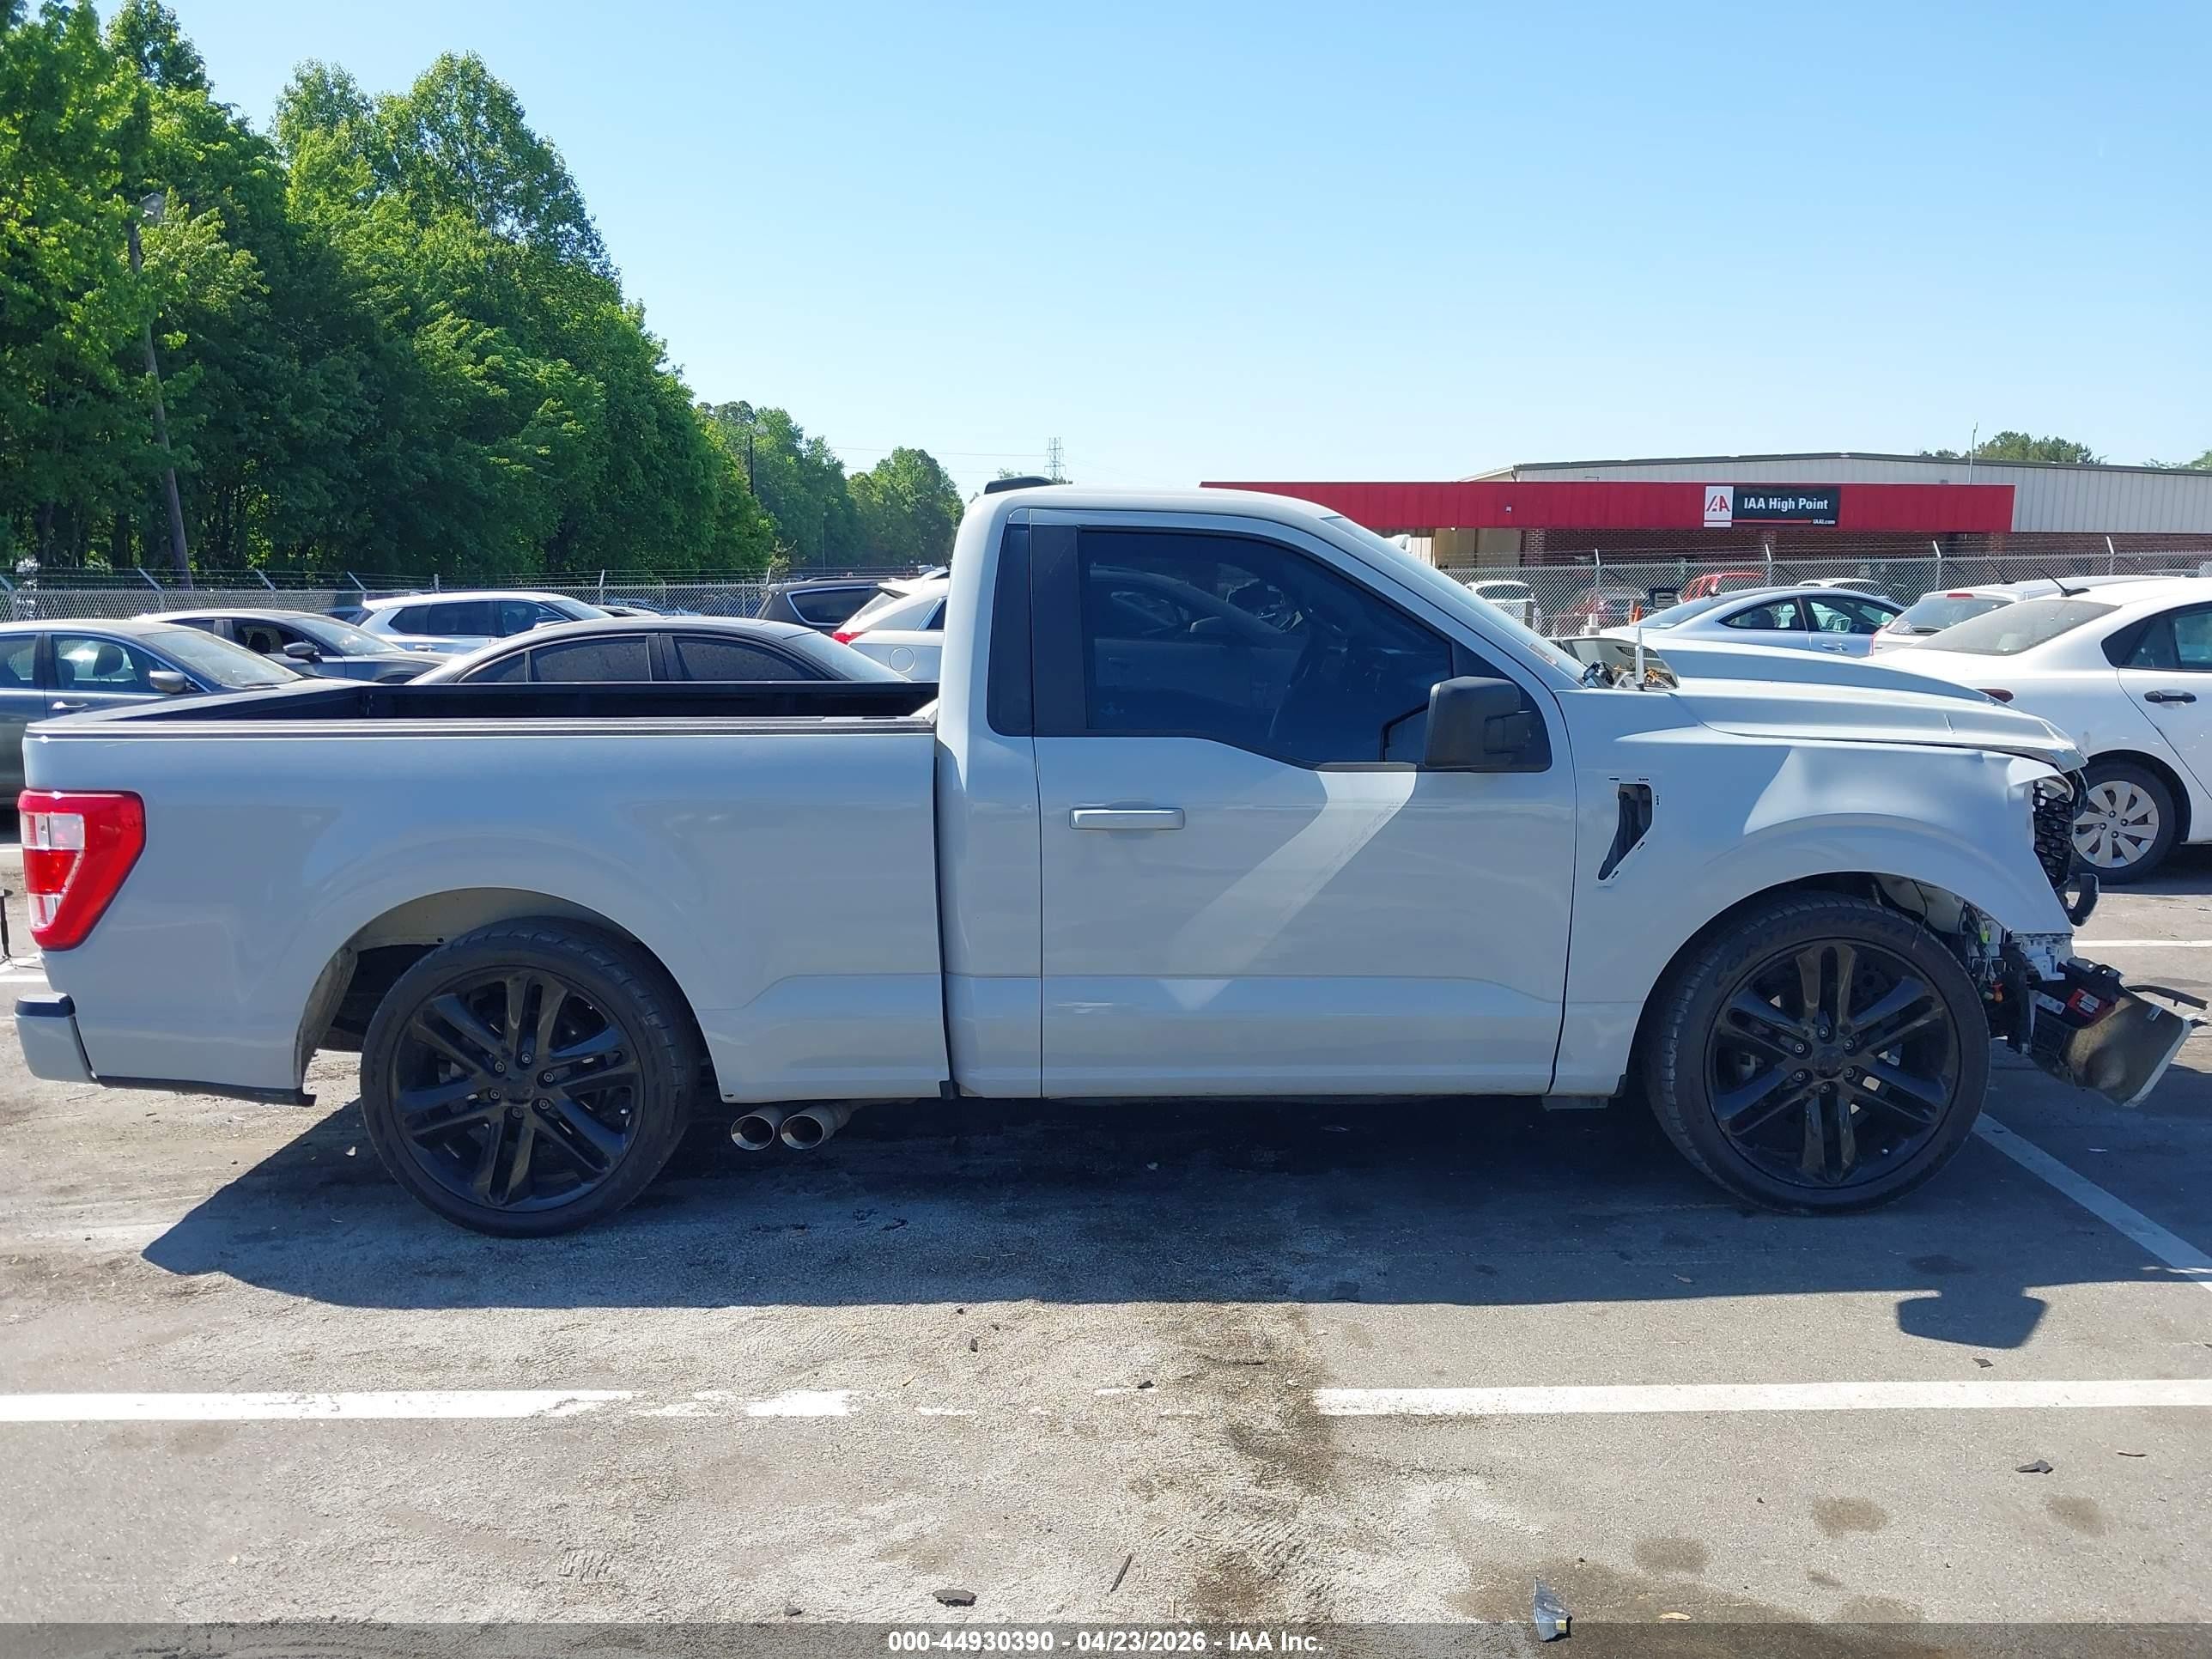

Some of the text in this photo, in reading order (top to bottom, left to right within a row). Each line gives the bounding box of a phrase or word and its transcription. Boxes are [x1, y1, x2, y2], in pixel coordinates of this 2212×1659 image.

[1743, 497, 1829, 513] IAA High Point
